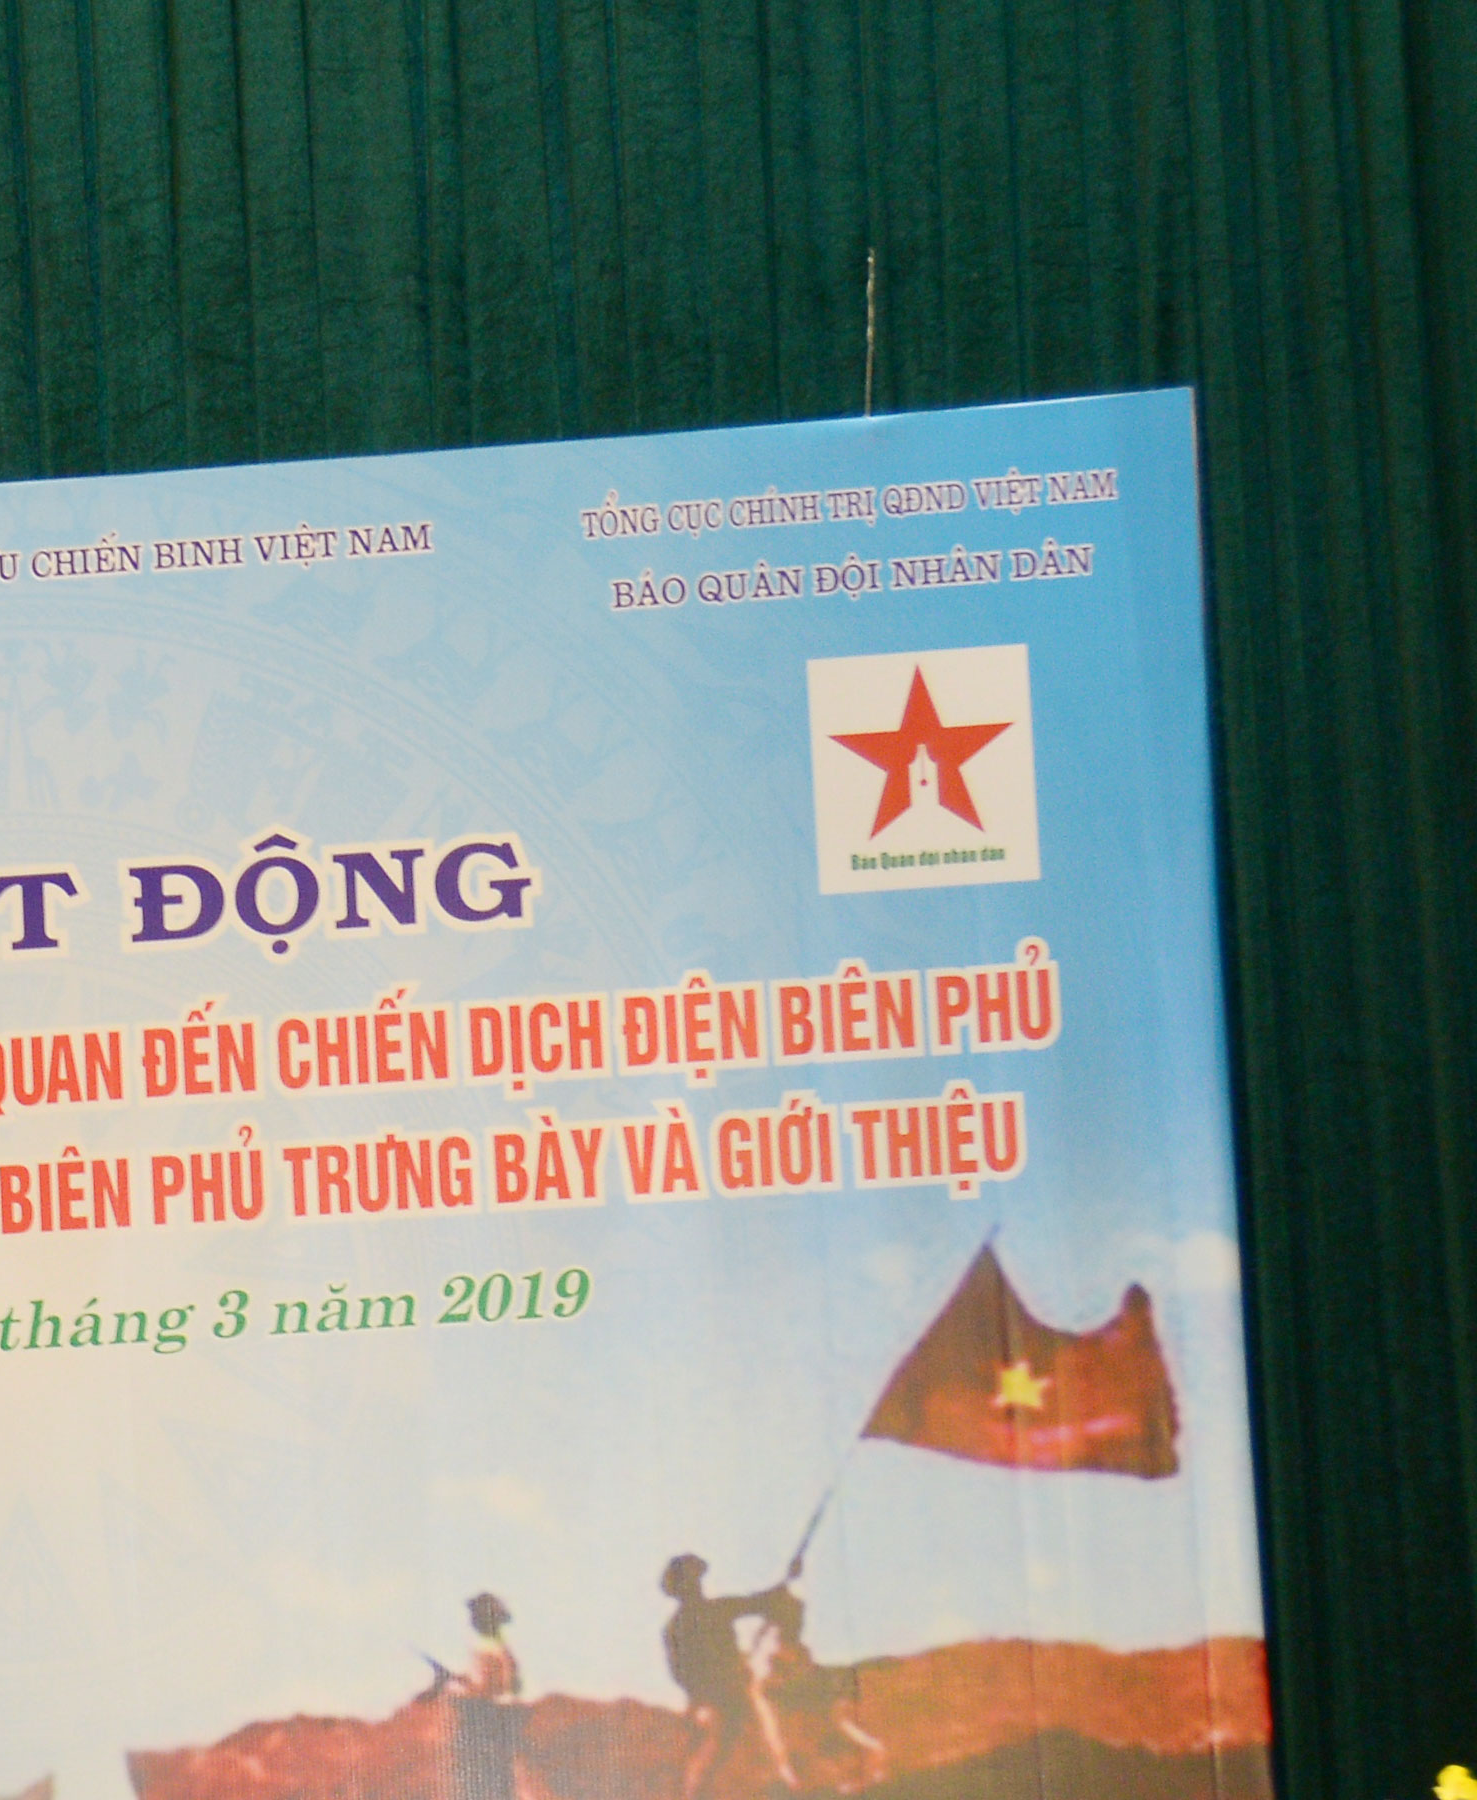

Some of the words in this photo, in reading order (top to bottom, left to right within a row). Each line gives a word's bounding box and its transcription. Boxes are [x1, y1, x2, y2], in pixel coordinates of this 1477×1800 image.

[582, 490, 658, 538] TỔNG
[668, 499, 721, 537] CỤC
[730, 487, 821, 528] CHÍNH
[829, 490, 876, 525] TRỊ
[884, 483, 967, 517] QĐND
[974, 470, 1041, 514] VIỆT
[1050, 470, 1117, 503] NAM
[32, 529, 142, 577] CHIẾN
[154, 537, 242, 570] BINH
[255, 525, 338, 567] VIỆT
[349, 524, 433, 556] NAM
[613, 570, 685, 609] BÁO
[698, 562, 802, 603] QUÂN
[816, 555, 880, 599] ĐỘI
[893, 545, 1001, 586] NHÂN
[1012, 538, 1092, 578] DÂN
[130, 834, 532, 955] ĐỘNG
[142, 1003, 255, 1097] ĐẾN
[277, 990, 446, 1091] CHIẾN
[470, 999, 603, 1089] DỊCH
[624, 973, 757, 1078] ĐIỆN
[780, 962, 922, 1057] BIÊN
[939, 943, 1052, 1048] PHỦ
[0, 1146, 129, 1236] BIÊN
[152, 1125, 261, 1224] PHỦ
[283, 1134, 470, 1215] TRƯNG
[493, 1116, 604, 1204] BÀY
[624, 1108, 699, 1194] VÀ
[720, 1093, 832, 1189] GIỚI
[853, 1087, 1020, 1192] THIỆU
[213, 1289, 248, 1338] 3
[268, 1283, 417, 1337] năm
[438, 1268, 591, 1326] 2019
